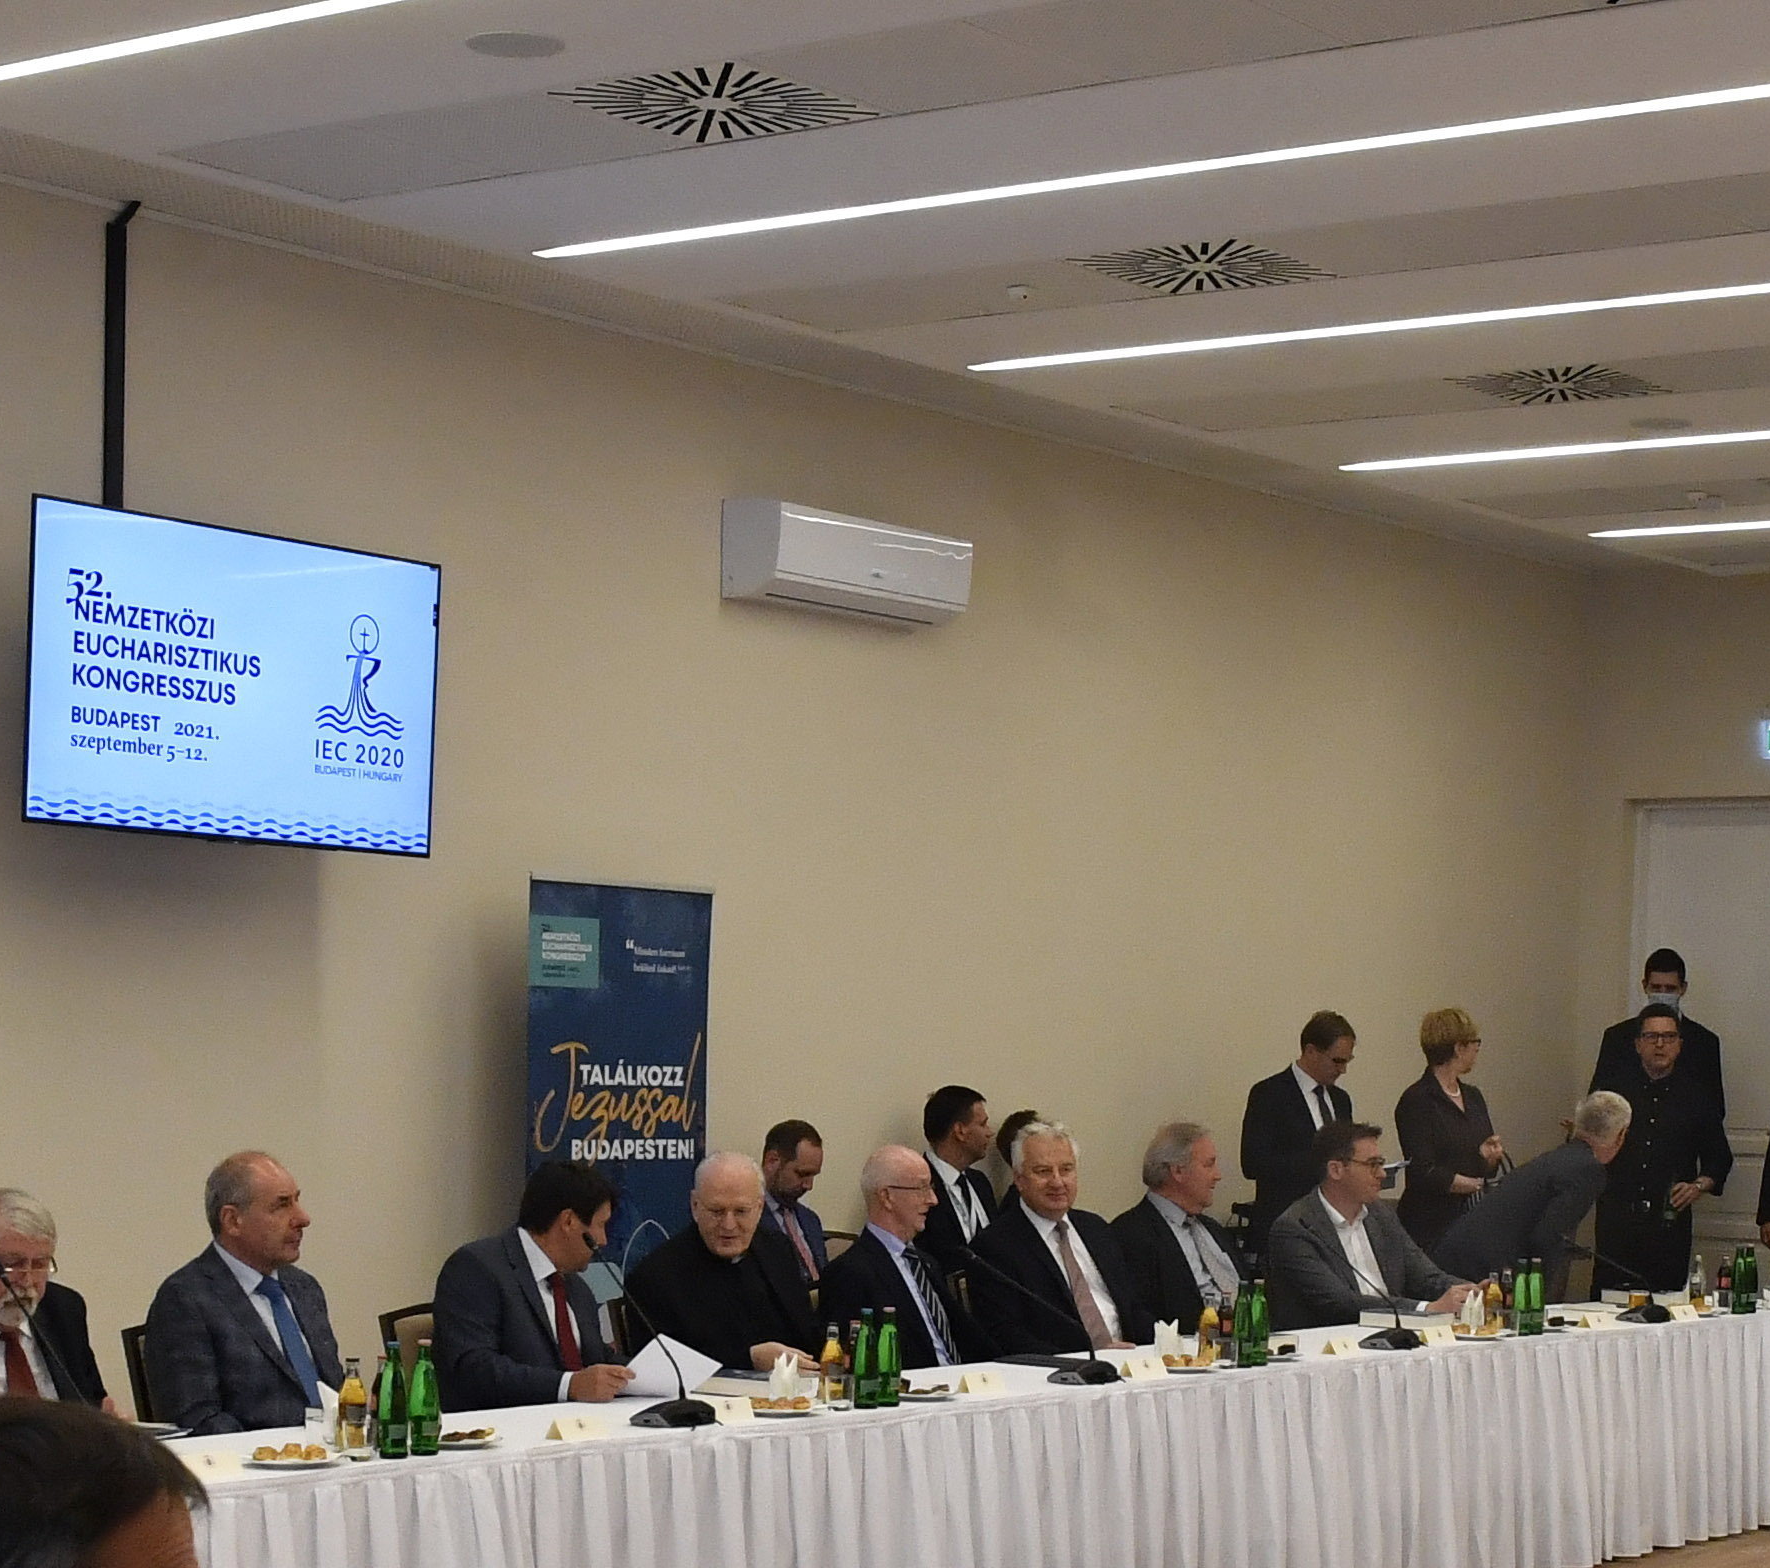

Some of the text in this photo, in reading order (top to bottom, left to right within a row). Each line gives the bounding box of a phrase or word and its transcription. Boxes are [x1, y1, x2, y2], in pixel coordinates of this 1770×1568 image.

[66, 567, 112, 604] 52.
[74, 599, 215, 640] NEMZETKÖZI
[73, 630, 261, 678] EUCHARISZTIKUS
[72, 662, 236, 706] KONGRESSZUS
[71, 705, 220, 740] BUDAPEST 2021.
[70, 734, 163, 755] szeptember
[315, 739, 404, 768] IEC 2020
[314, 764, 403, 783] BUDAPEST HUNGARY
[580, 1059, 684, 1087] TALÁLKOZZ
[571, 1138, 695, 1162] BUDAPESTEN!
